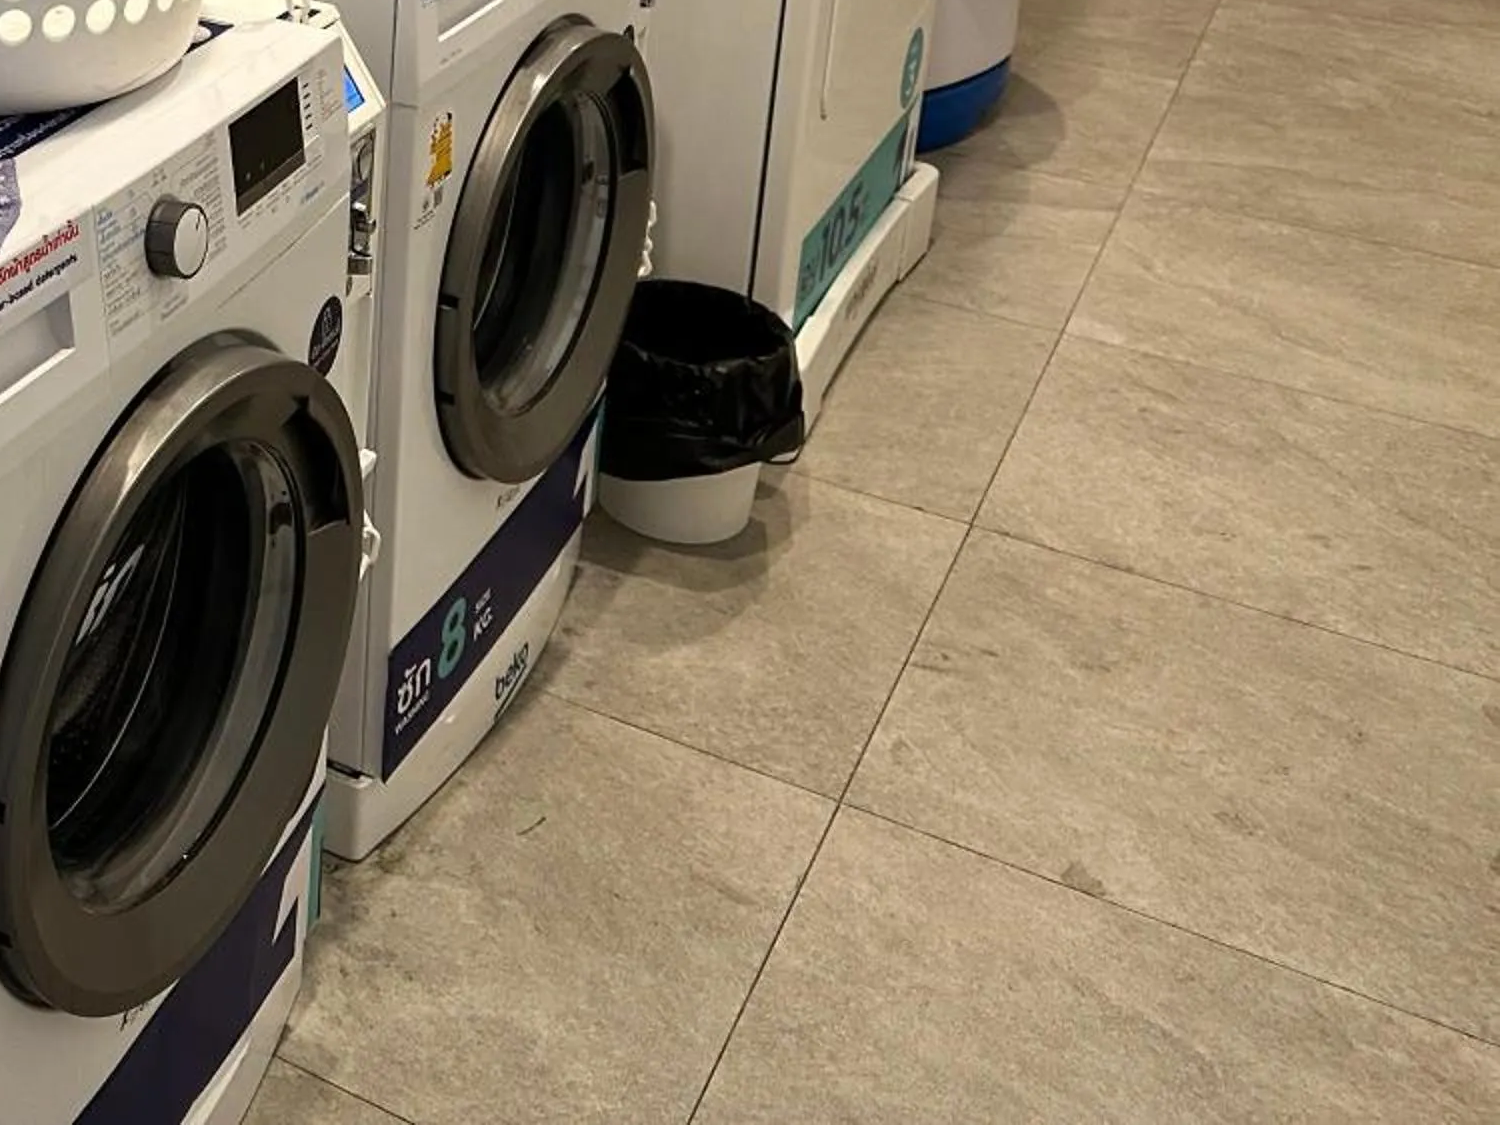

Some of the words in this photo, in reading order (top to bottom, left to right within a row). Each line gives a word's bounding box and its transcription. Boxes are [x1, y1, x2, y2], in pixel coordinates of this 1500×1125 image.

[397, 658, 431, 715] ซัก
[438, 597, 467, 679] 8
[495, 642, 529, 701] beko
